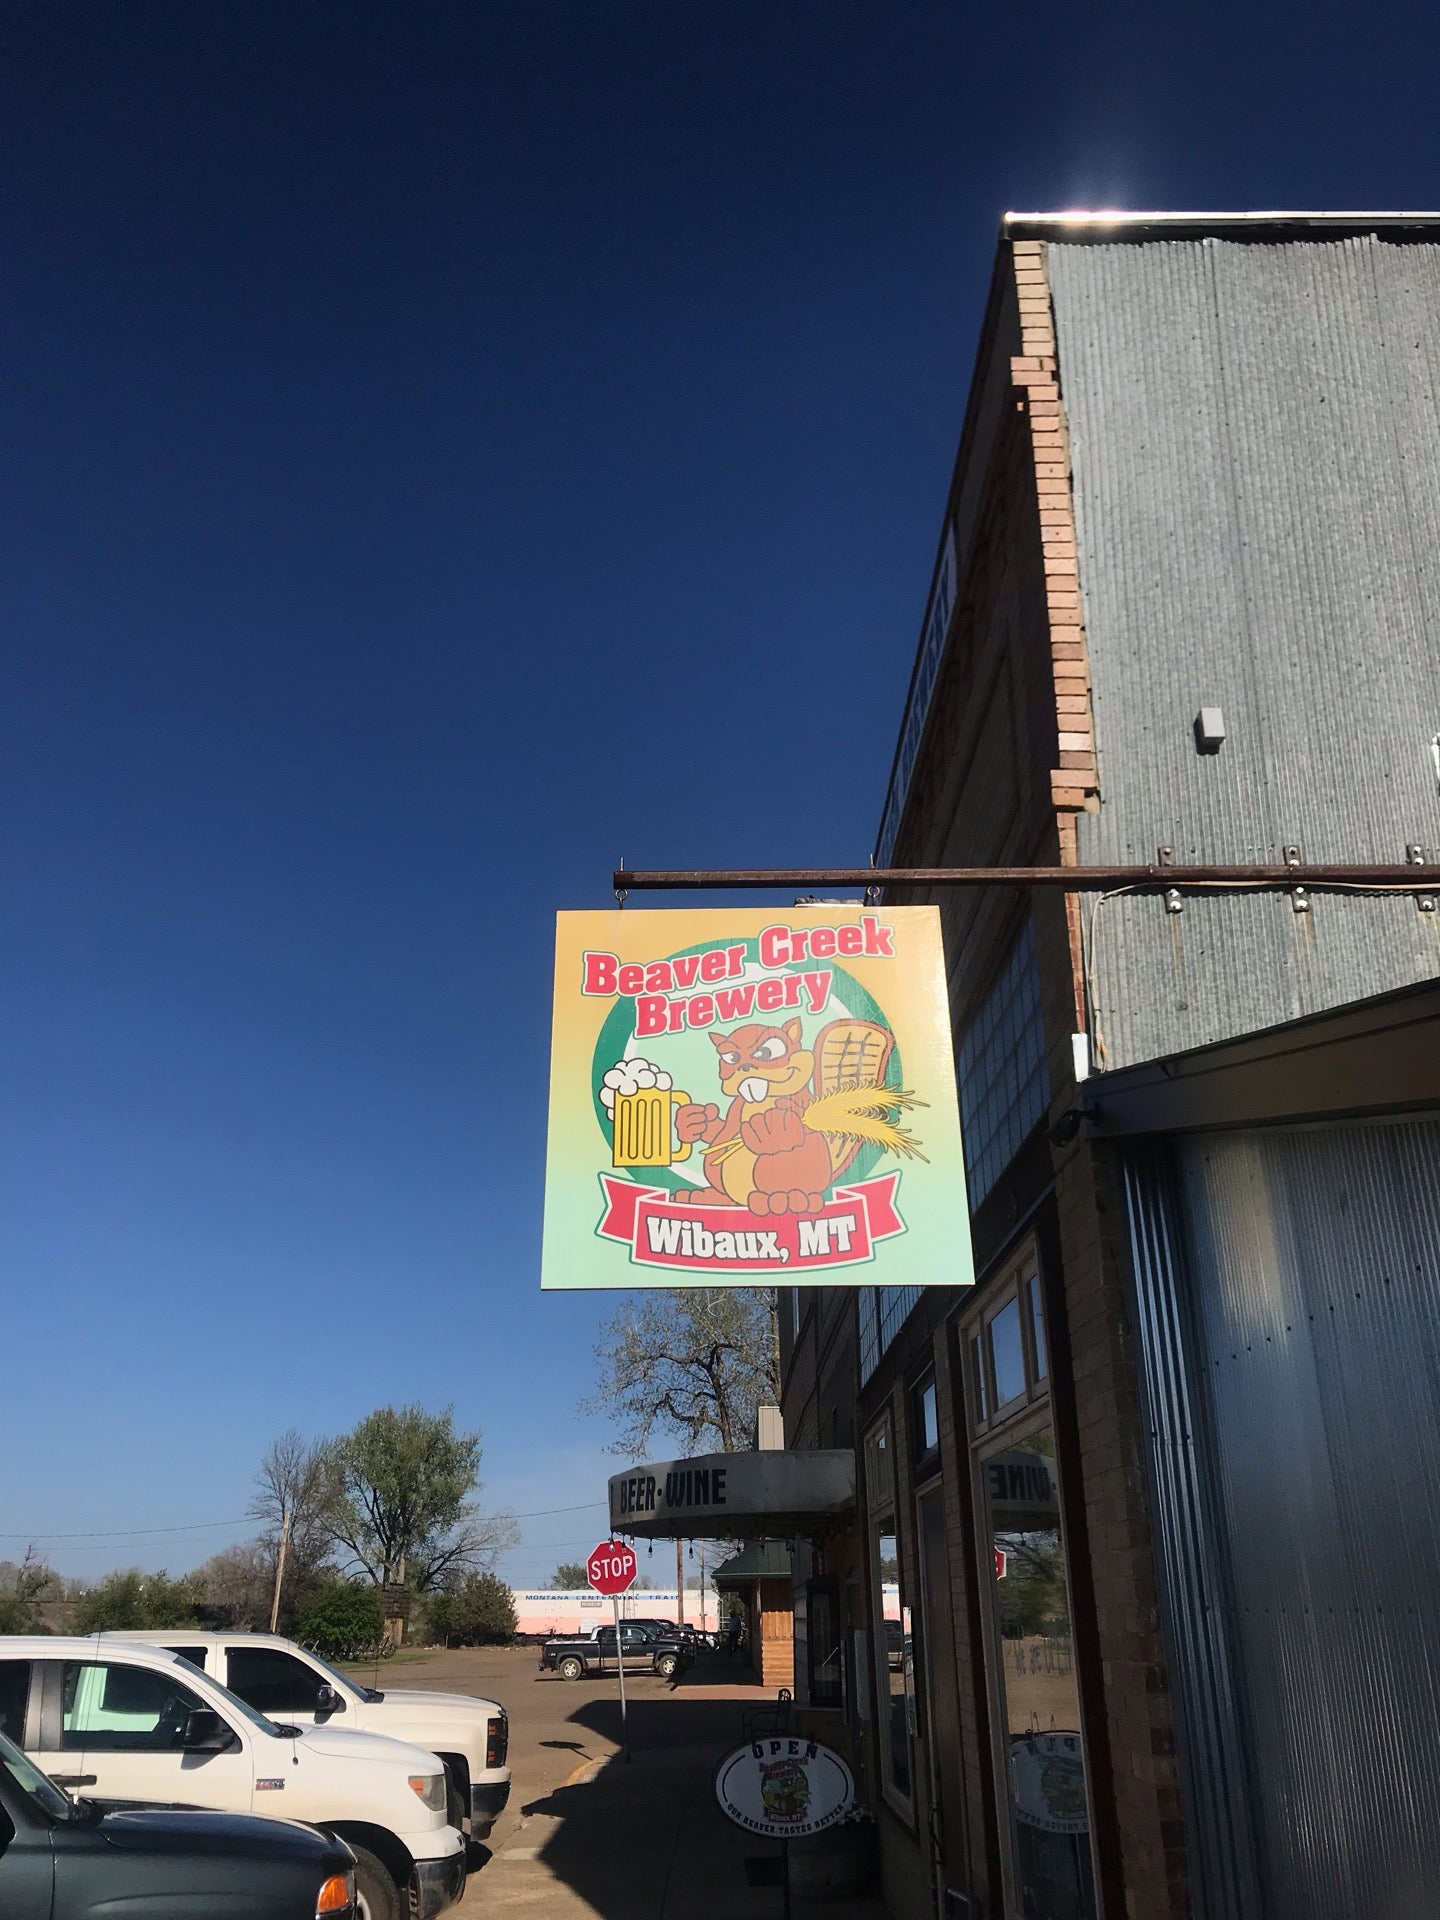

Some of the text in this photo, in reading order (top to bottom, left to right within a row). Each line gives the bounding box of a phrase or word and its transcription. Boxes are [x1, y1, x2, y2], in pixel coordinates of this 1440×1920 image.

[583, 917, 895, 996] Beaver Creek
[635, 971, 832, 1037] Brewery
[645, 1215, 855, 1263] Wibaux, MT
[620, 1476, 656, 1513] BEER
[666, 1469, 727, 1507] WINE
[590, 1555, 634, 1581] STOP
[752, 1740, 819, 1760] OPEN
[727, 1803, 845, 1835] OUR BEAVER TASTES BETTER
